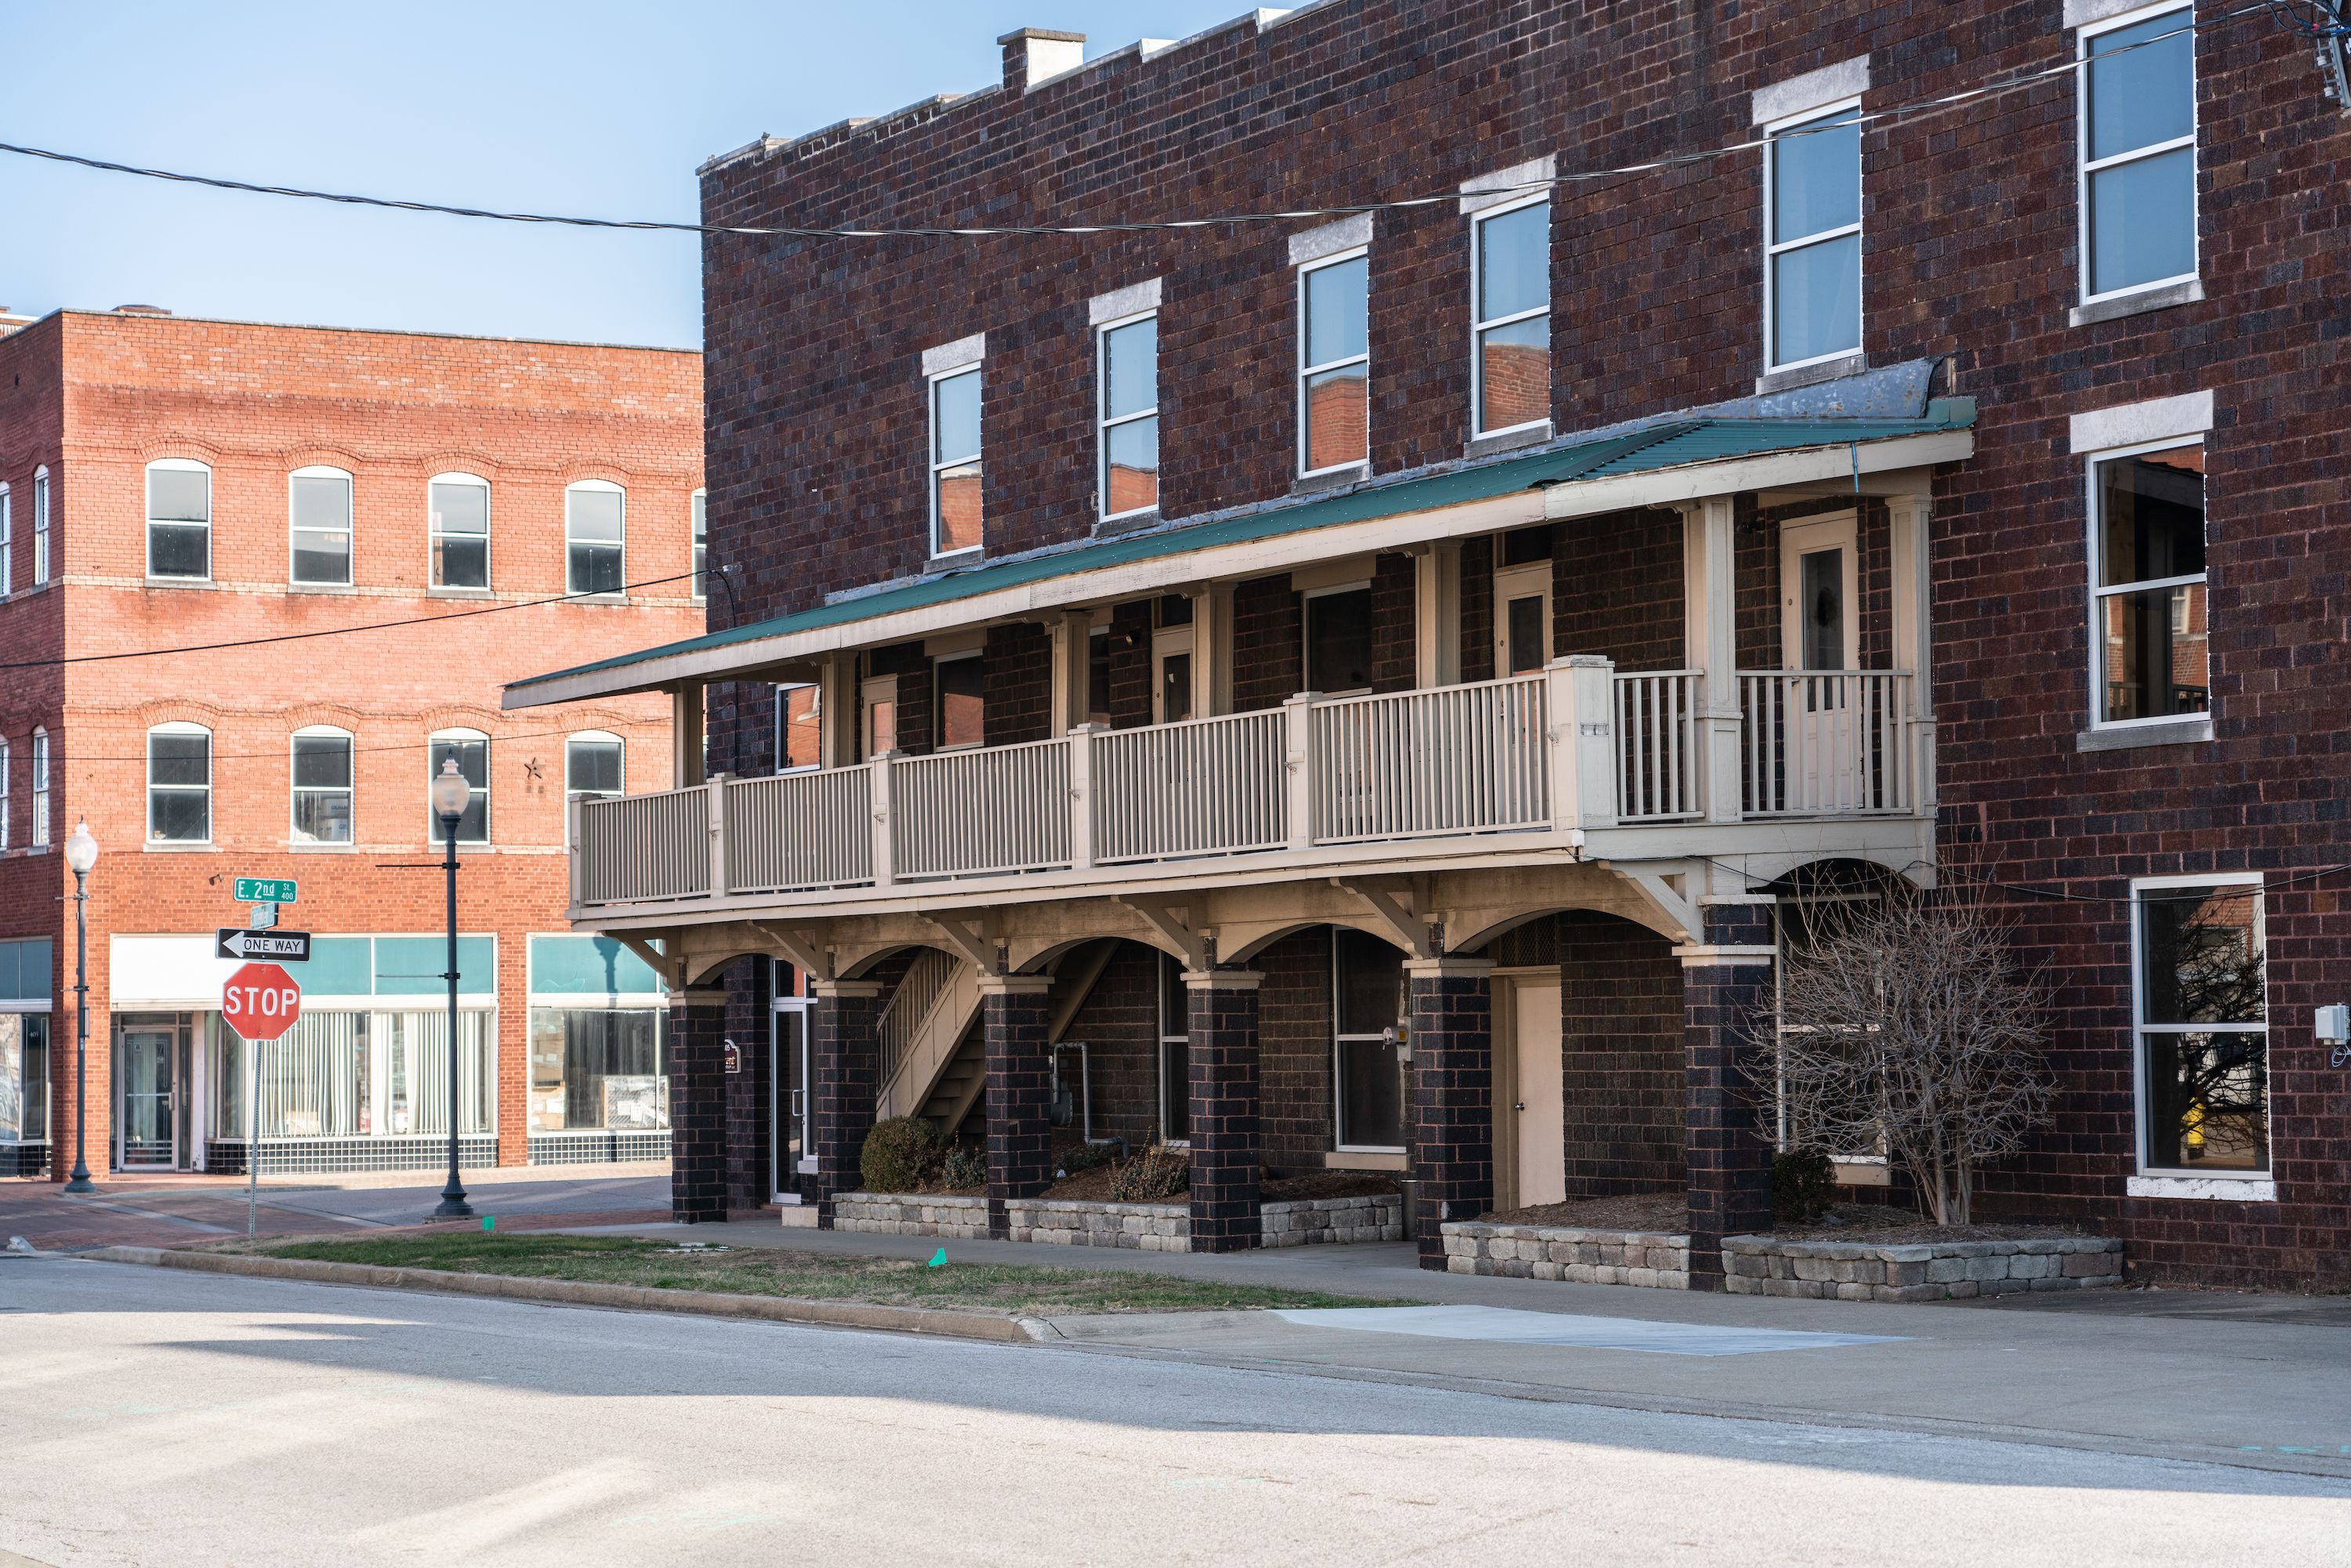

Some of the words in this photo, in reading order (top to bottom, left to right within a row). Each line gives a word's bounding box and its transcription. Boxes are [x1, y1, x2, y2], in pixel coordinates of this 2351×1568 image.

[238, 881, 248, 898] E.
[254, 882, 274, 899] 2nd
[283, 882, 292, 891] St.
[281, 892, 293, 900] 400
[244, 939, 270, 951] ONE
[275, 940, 300, 952] WAY
[226, 986, 297, 1017] STOP
